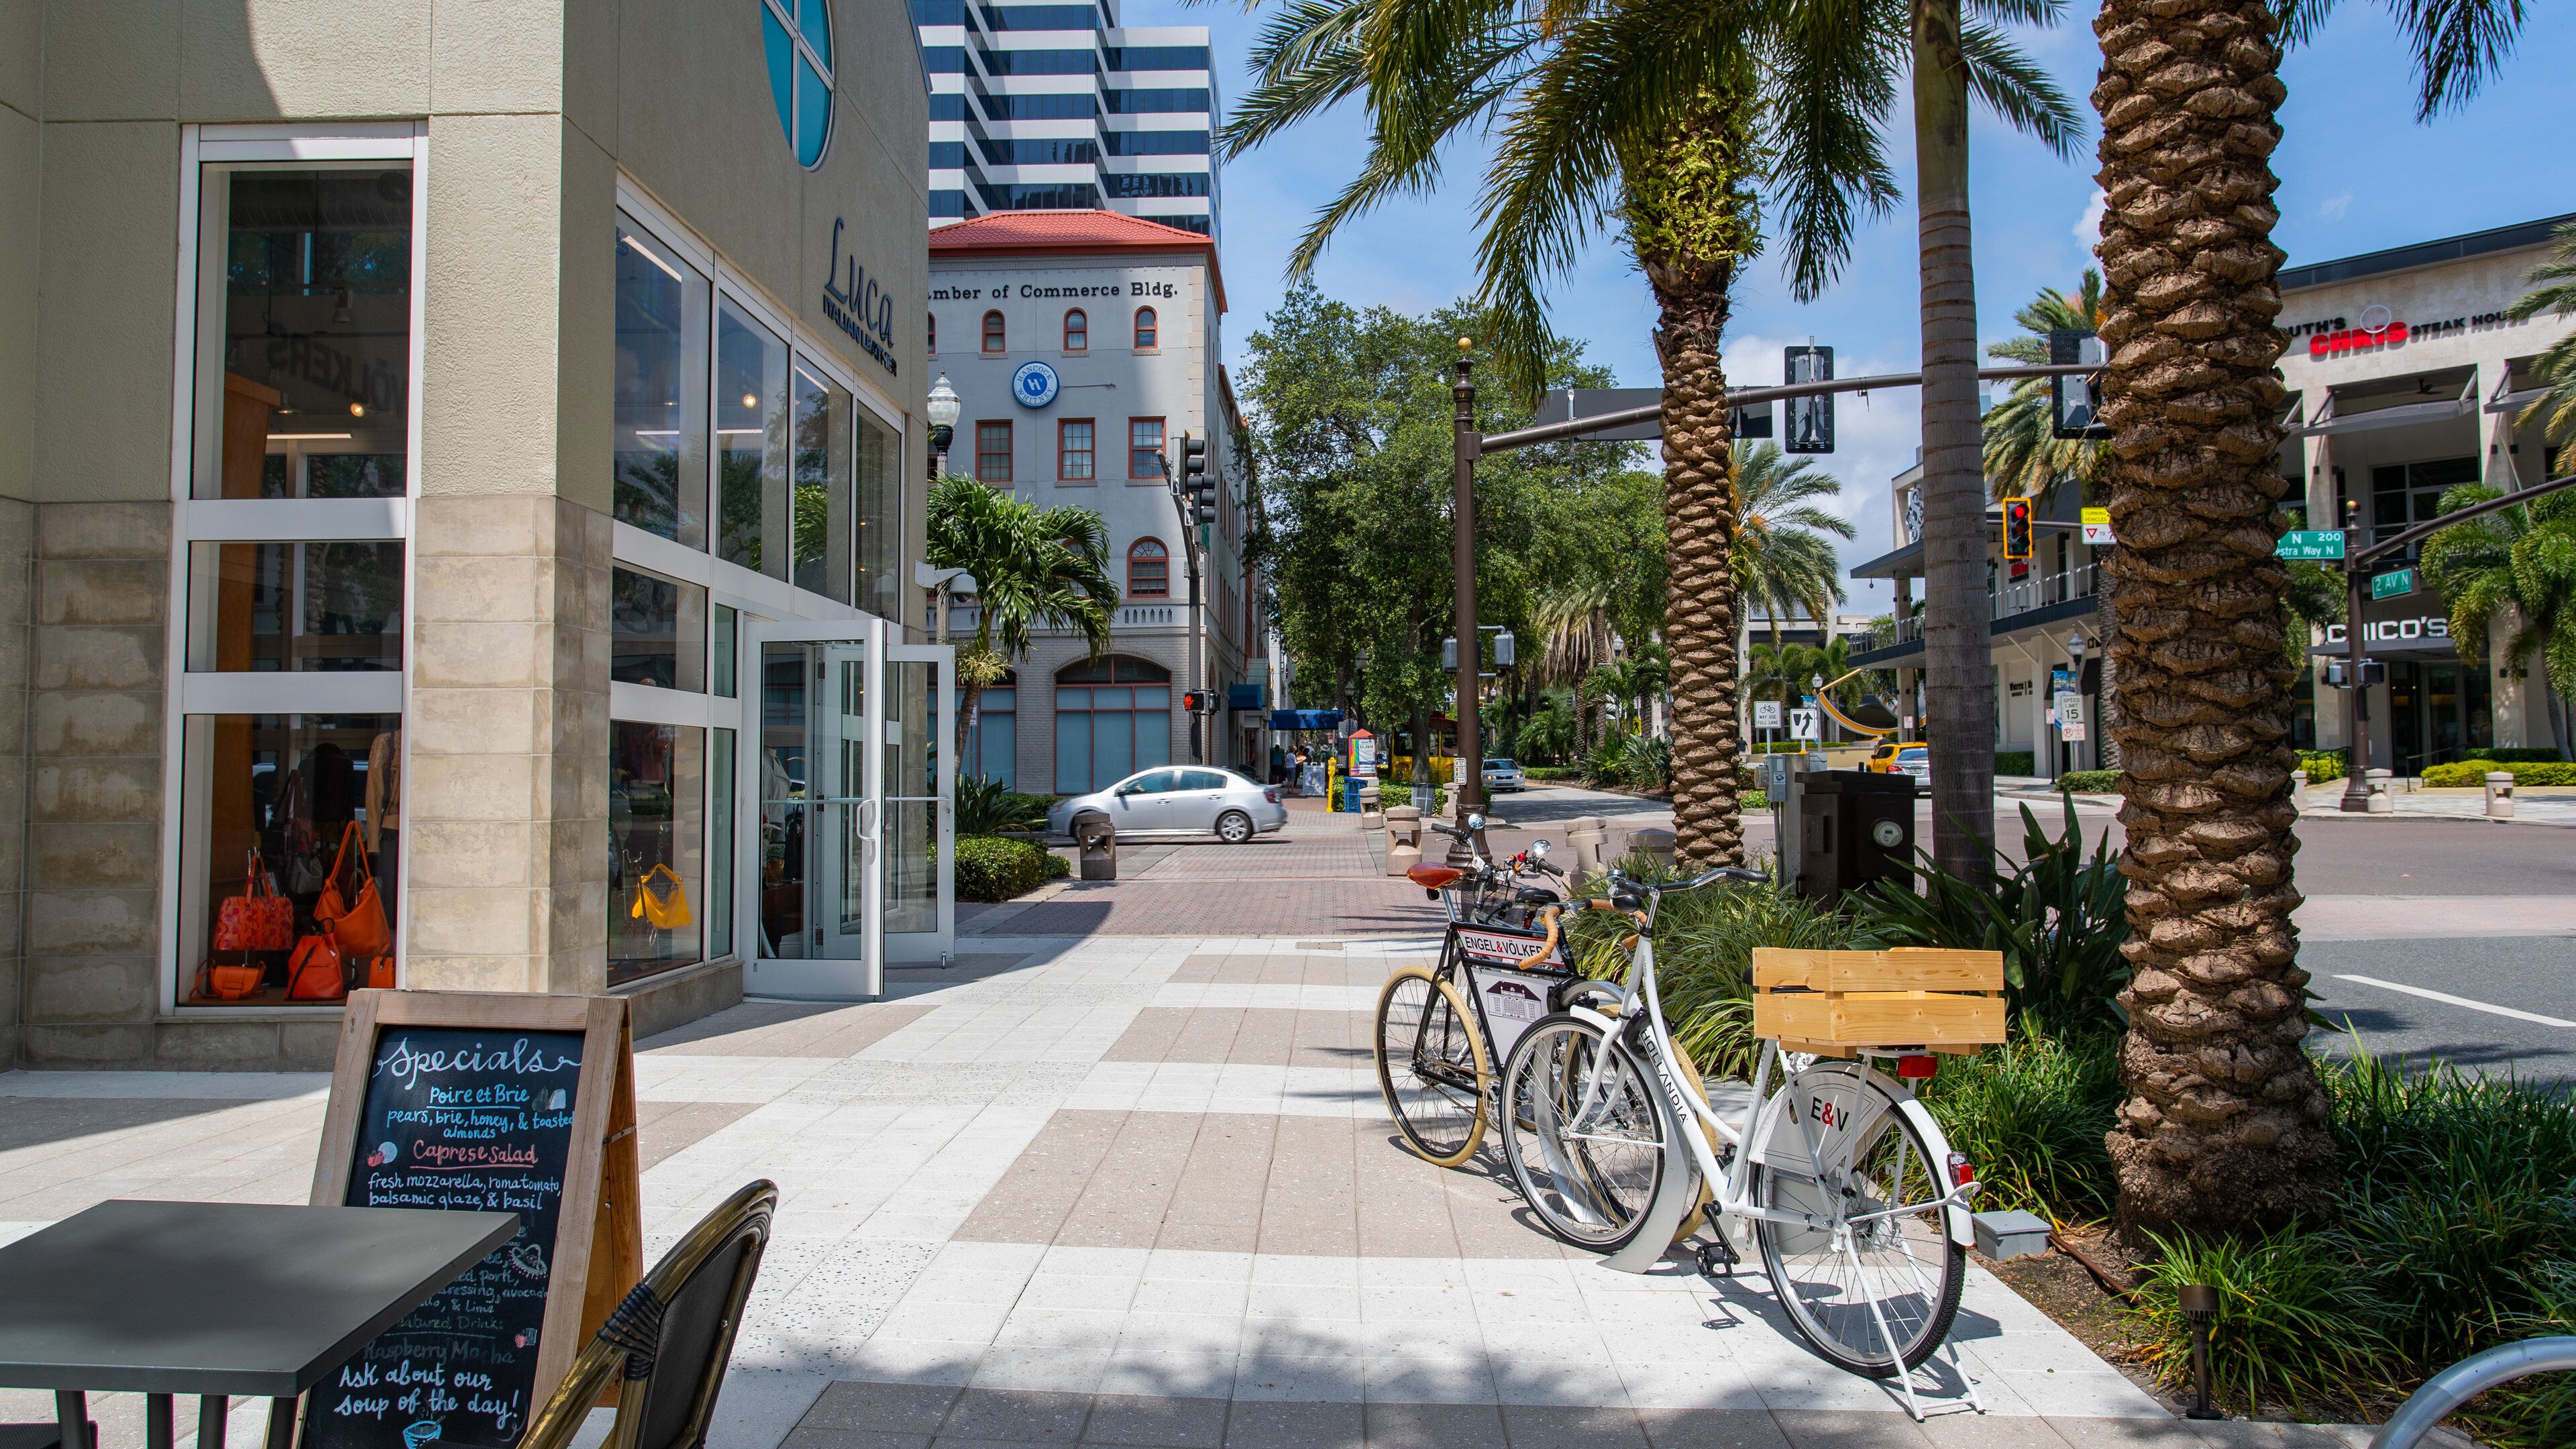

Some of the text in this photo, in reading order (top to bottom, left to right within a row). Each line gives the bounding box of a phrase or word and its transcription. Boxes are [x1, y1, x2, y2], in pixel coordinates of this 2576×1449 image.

[824, 217, 894, 348] Luca
[991, 285, 1010, 299] of
[1020, 284, 1120, 297] Commerce
[1130, 282, 1179, 299] Bldg.
[823, 294, 897, 377] ITALIAN LEATHER
[2287, 317, 2346, 337] UTH'S
[2410, 317, 2465, 336] STEAK
[2310, 321, 2408, 355] CHRIS
[1018, 366, 1053, 381] HANCOCK
[1018, 387, 1053, 402] WHITNEY
[2292, 533, 2341, 544] N 200
[2302, 546, 2321, 557] Way
[2326, 545, 2334, 555] N
[2375, 578, 2381, 591] 2
[2385, 574, 2398, 590] AV
[2402, 573, 2408, 586] N
[2326, 616, 2448, 643] CICO'S
[2066, 709, 2079, 719] 15
[382, 1037, 560, 1091] Specials
[1641, 1028, 1688, 1126] HOLLANDIA
[429, 1084, 530, 1104] Poire et Brie
[387, 1109, 575, 1133] pears, brie, honey, & toasted
[1809, 1095, 1851, 1133] E&V
[443, 1125, 496, 1139] almonds
[413, 1140, 488, 1165] Caprese
[368, 1172, 403, 1189] fresh
[407, 1173, 486, 1193] mozzarella,
[370, 1190, 543, 1211] balsamic glaze, & basil
[451, 1299, 461, 1311] &
[450, 1340, 516, 1364] Mocha
[339, 1358, 493, 1391] Ask about our
[333, 1387, 519, 1430] soup of the day!
